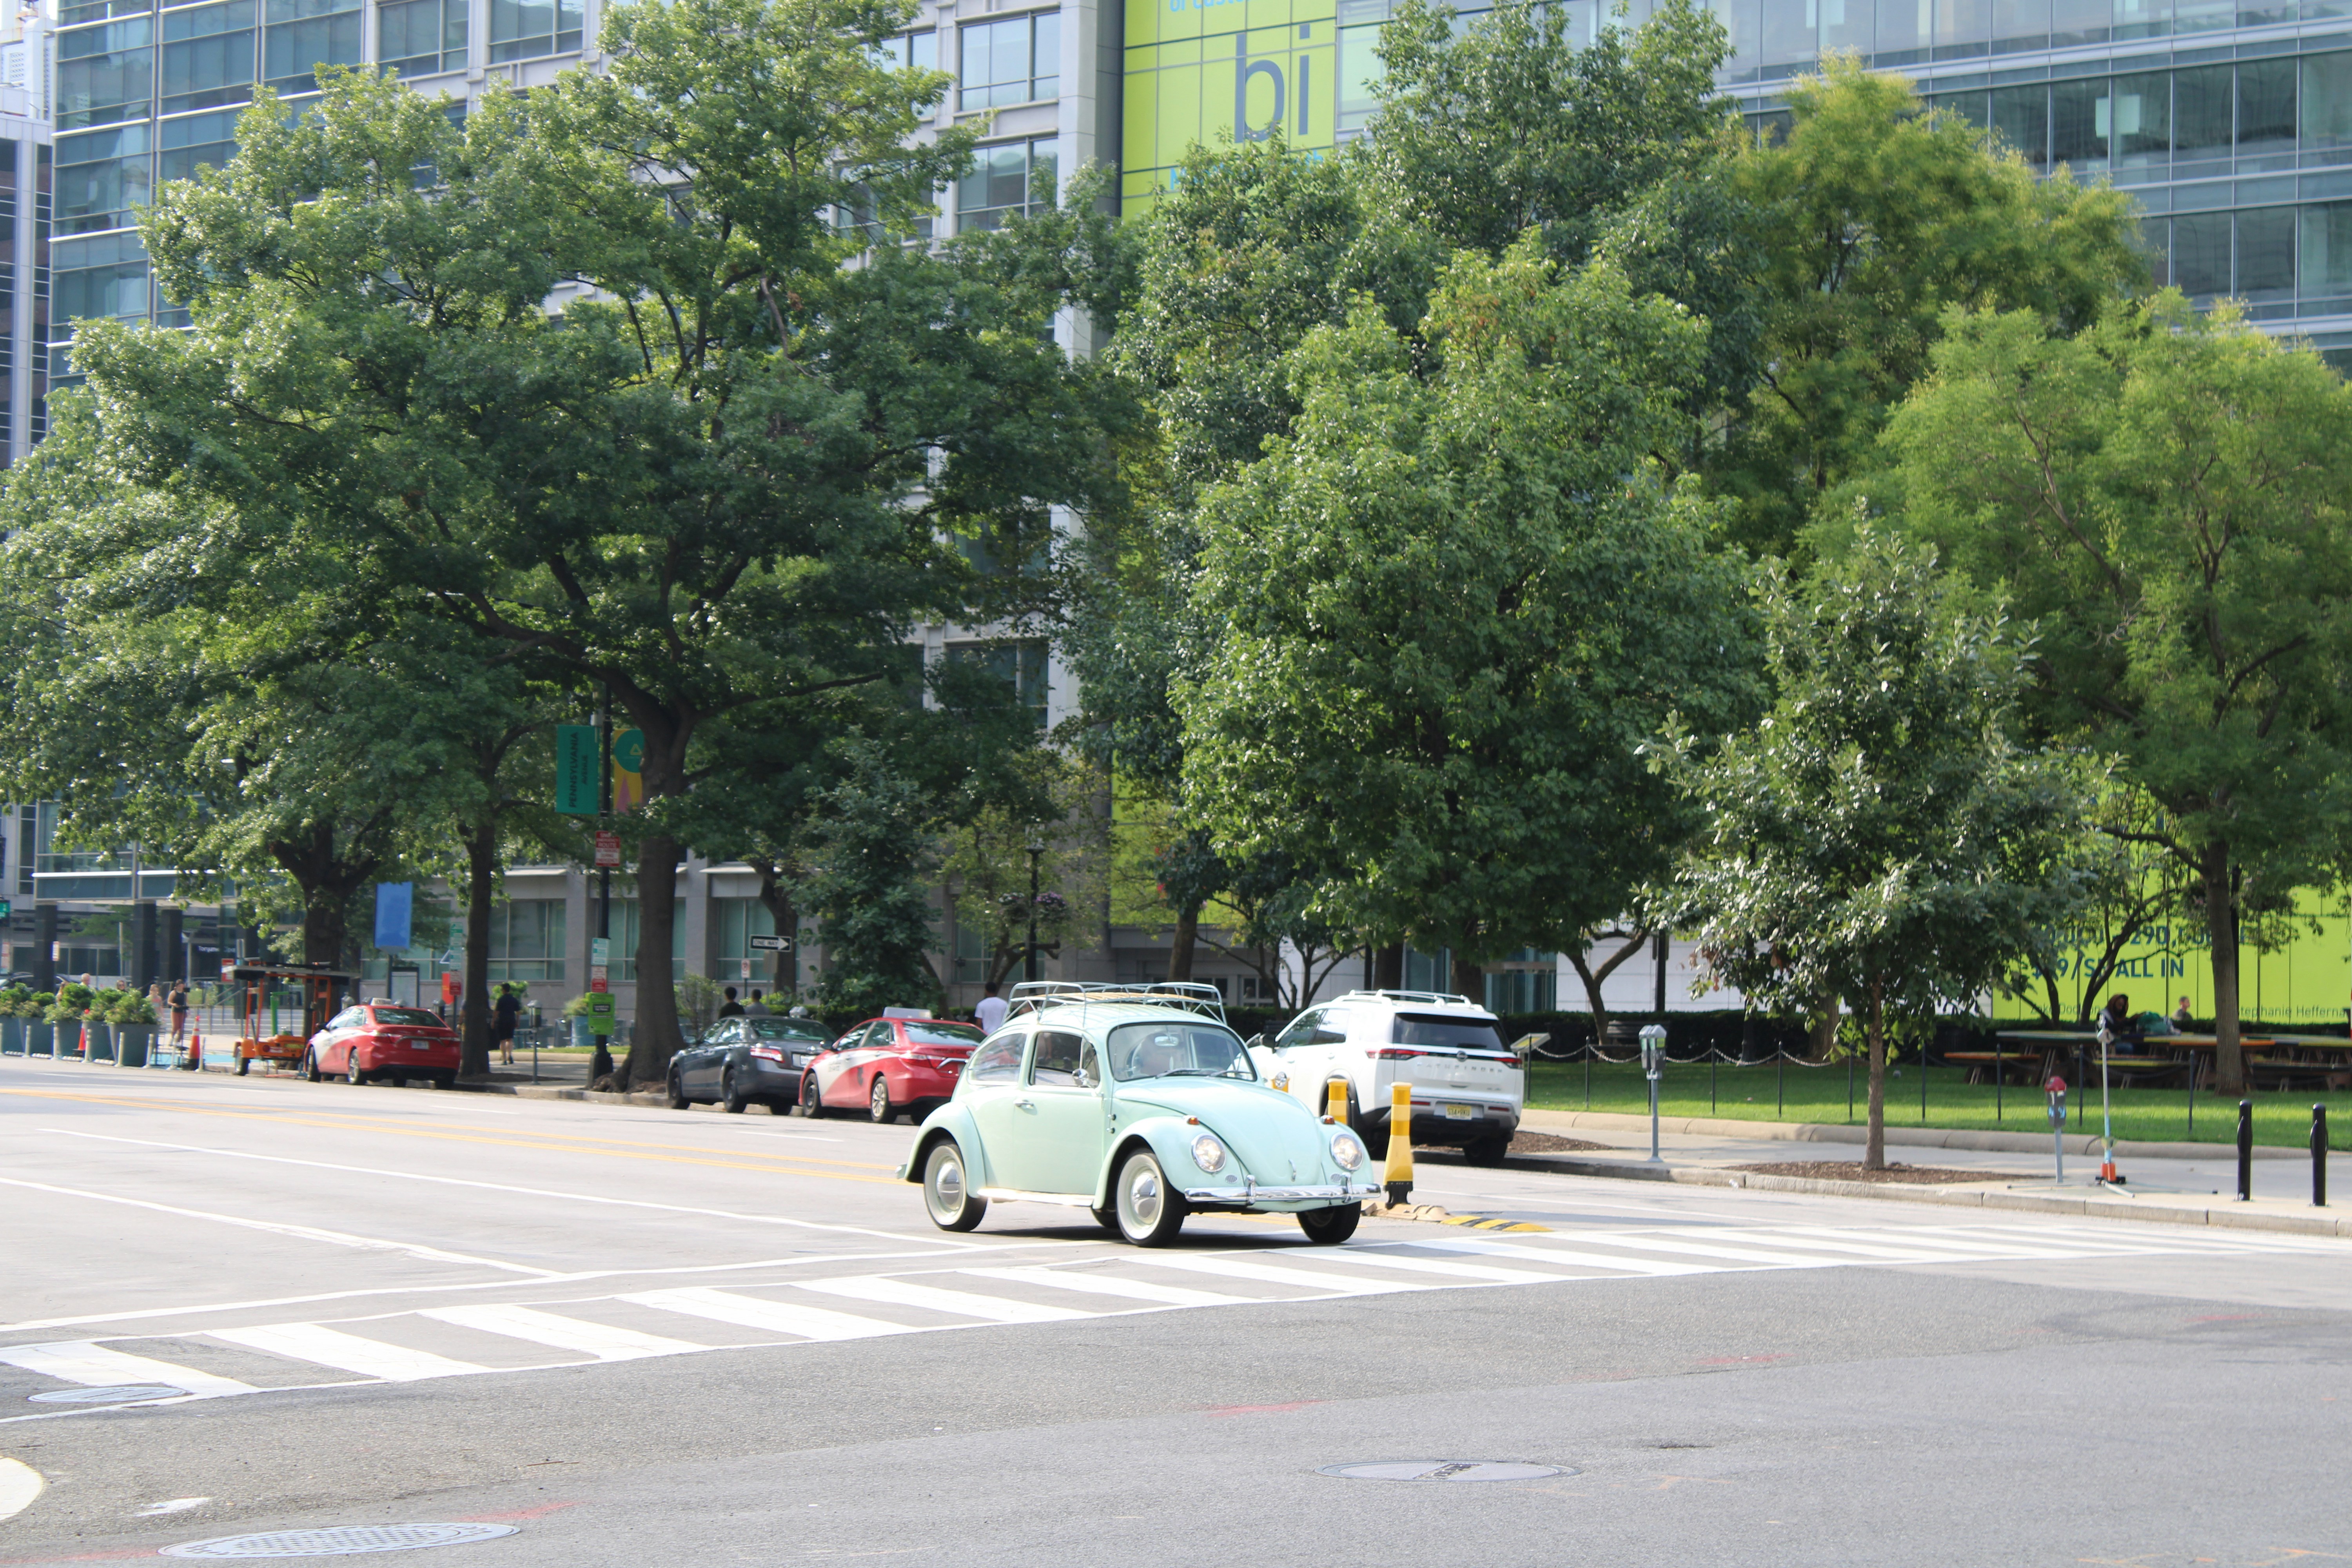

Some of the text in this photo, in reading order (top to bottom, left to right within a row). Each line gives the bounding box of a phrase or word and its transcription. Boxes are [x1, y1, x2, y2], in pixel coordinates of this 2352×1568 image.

[1234, 24, 1310, 143] bi
[569, 731, 579, 808] PENNSYLVANIA
[2115, 958, 2154, 978] ALL
[2161, 958, 2184, 978] IN
[2240, 1004, 2346, 1020] tephanie Hefferna
[1417, 1062, 1503, 1073] PATHFINDER
